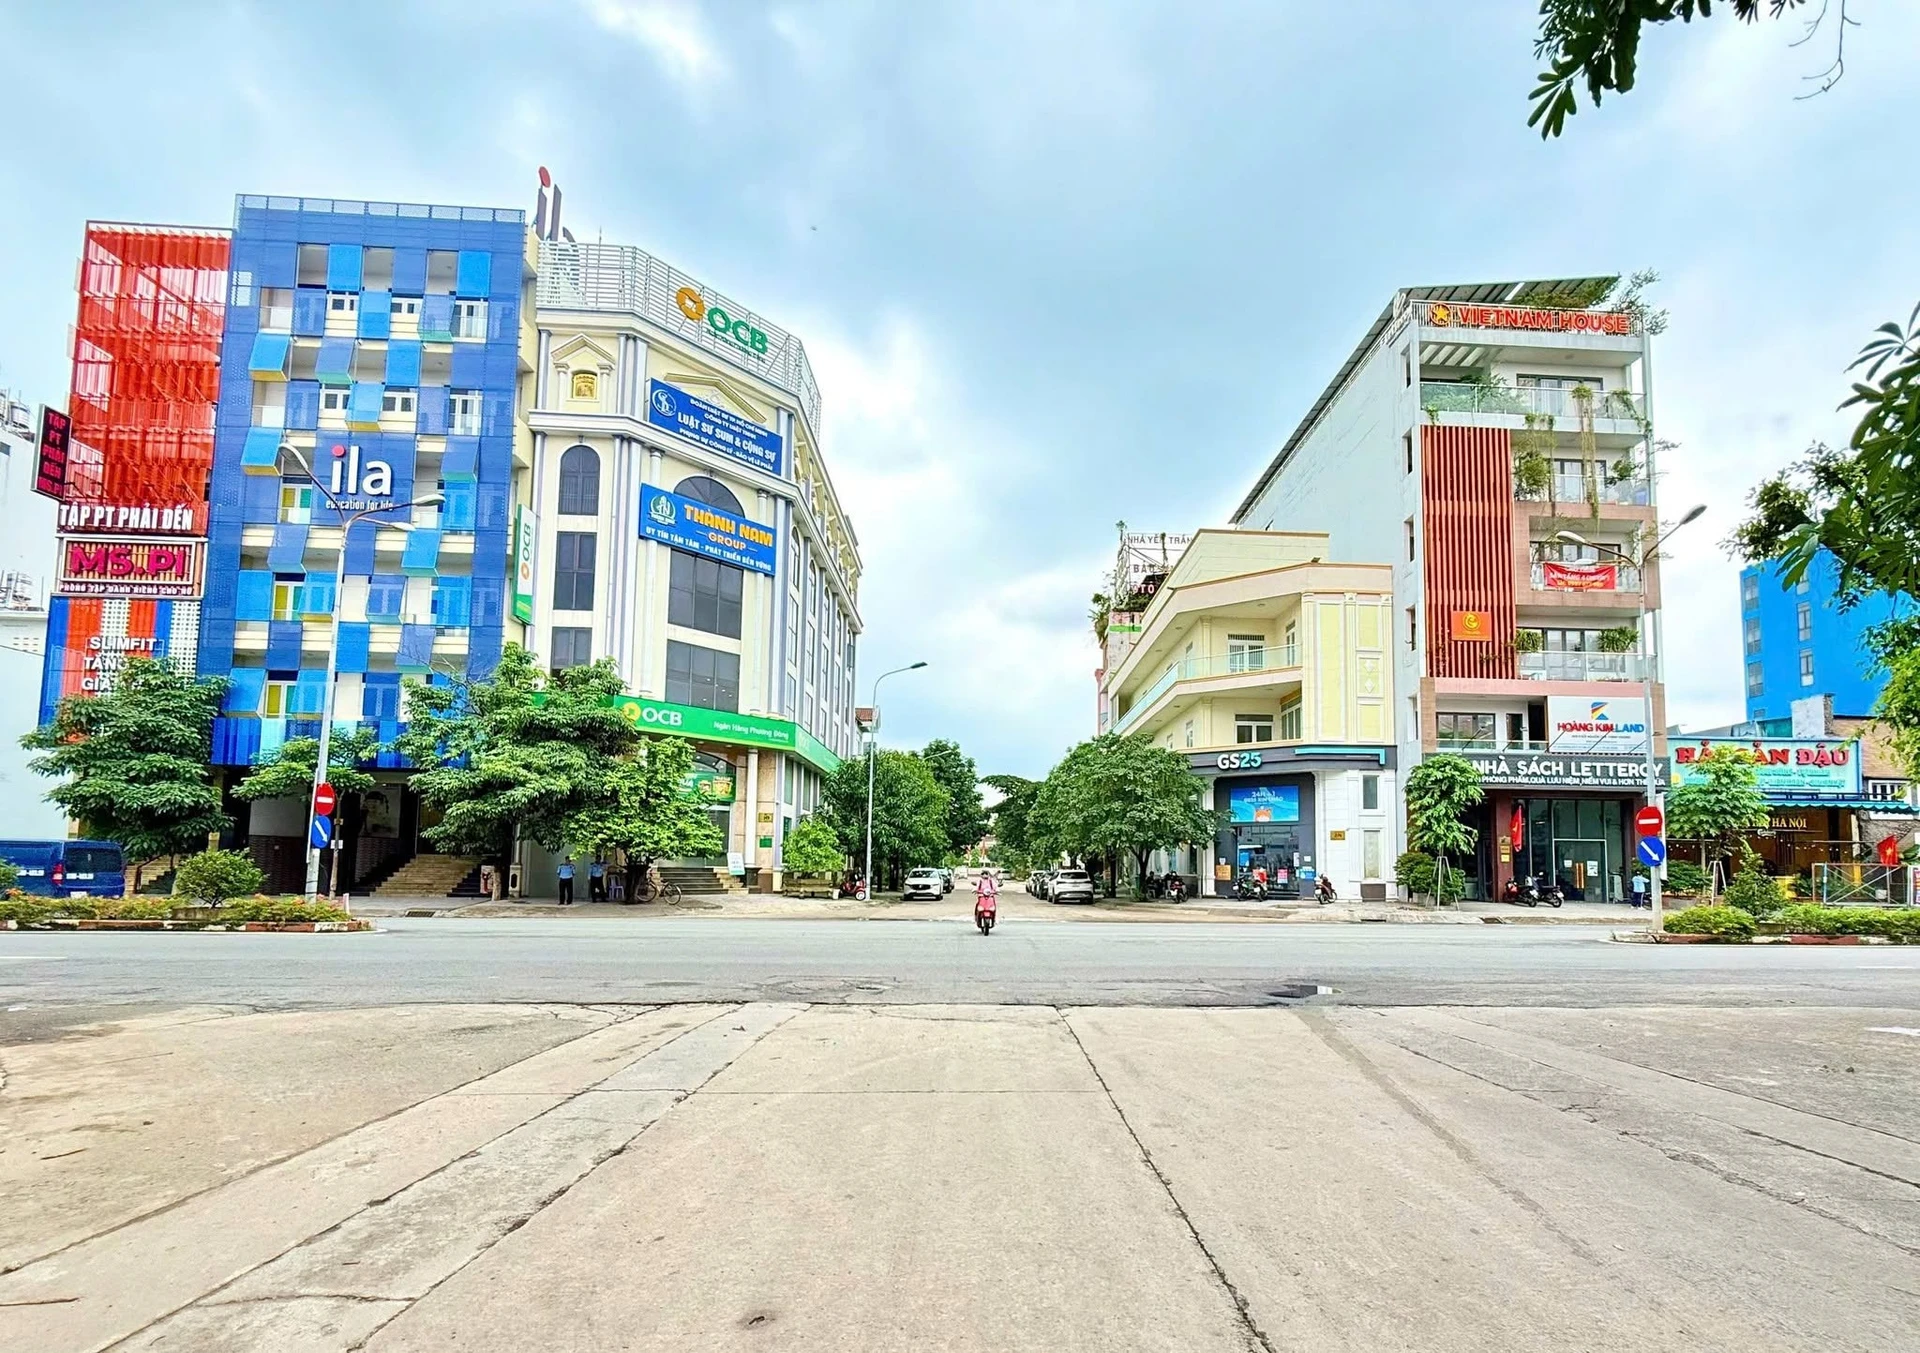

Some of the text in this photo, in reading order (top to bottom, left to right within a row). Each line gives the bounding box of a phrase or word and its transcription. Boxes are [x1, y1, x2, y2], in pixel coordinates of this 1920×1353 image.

[707, 307, 768, 355] OCB
[1458, 306, 1630, 334] VIETNAM HOUSE
[678, 412, 777, 463] LUẬT SƯ SUM & CỘNG SỰ
[331, 445, 392, 496] ila
[60, 502, 193, 531] TẬP PT PHẢI ĐẾN
[367, 500, 379, 511] for
[684, 504, 736, 535] THÀNH
[739, 523, 773, 547] NAM
[522, 523, 531, 561] OCB
[645, 526, 656, 535] UY
[657, 528, 669, 539] TÍN
[685, 537, 700, 549] TÂM
[705, 544, 722, 556] PHÁT
[708, 532, 747, 551] GROUP
[71, 546, 187, 577] MS.PI
[90, 636, 157, 651] SLIMFIT
[642, 706, 683, 726] OCB
[713, 721, 731, 730] Ngân
[732, 722, 749, 734] Hàng
[1557, 720, 1645, 733] HOÀNG KIM LAND
[1217, 752, 1262, 769] GS25
[1472, 755, 1510, 775] NHÀ
[1517, 755, 1564, 776] SÁCH
[1675, 740, 1715, 764] HẢ
[1796, 743, 1849, 767] ĐẬU
[1482, 776, 1507, 784] PHÒNG
[1772, 815, 1787, 828] HÀ
[1788, 815, 1807, 829] NỘI
